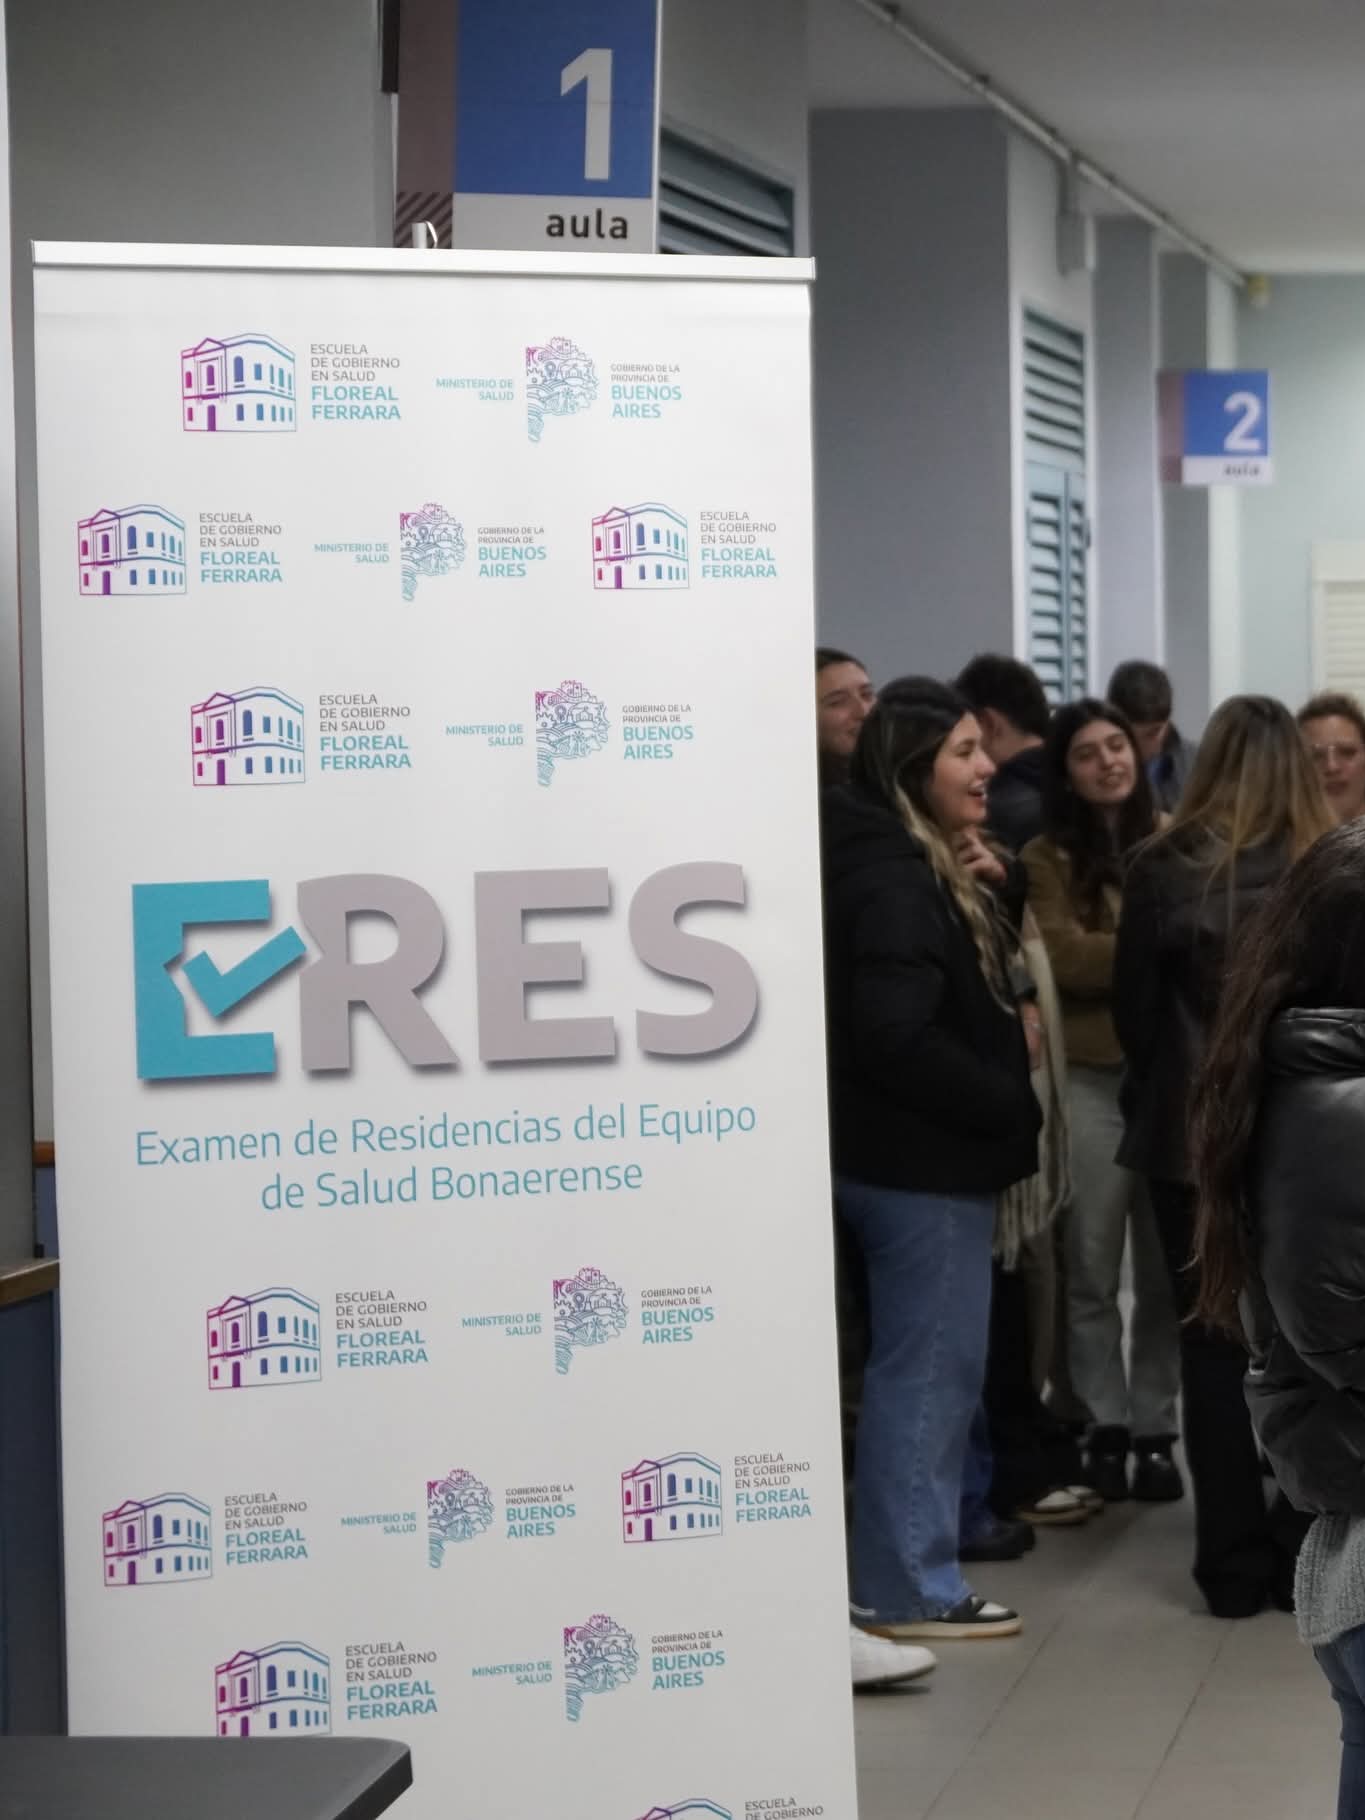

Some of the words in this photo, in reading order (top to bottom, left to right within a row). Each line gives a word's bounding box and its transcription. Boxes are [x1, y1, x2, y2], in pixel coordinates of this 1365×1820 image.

[560, 47, 614, 181] 1
[546, 209, 629, 240] aula
[310, 343, 369, 356] ESCUELA
[310, 356, 329, 369] DE
[331, 356, 401, 369] GOBIERNO
[610, 363, 655, 373] GOBIERNO
[655, 364, 668, 373] DE
[668, 364, 681, 374] LA
[311, 369, 329, 382] EN
[331, 369, 376, 382] SALUD
[435, 377, 497, 390] MINISTERIO
[496, 378, 514, 390] DE
[610, 373, 656, 384] PROVINCIA
[657, 374, 670, 384] DE
[311, 384, 399, 401] FLOREAL
[478, 390, 515, 401] SALUD
[611, 384, 683, 401] BUENOS
[311, 404, 402, 421] FERRARA
[611, 402, 662, 419] AIRES
[1224, 391, 1261, 450] 2
[199, 511, 253, 524] ESCUELA
[700, 511, 750, 521] ESCUELA
[199, 524, 217, 536] DE
[218, 524, 282, 536] GOBIERNO
[477, 527, 520, 535] GOBIERNO
[520, 526, 533, 536] DE
[533, 527, 545, 535] LA
[700, 522, 716, 533] DE
[717, 522, 777, 533] GOBIERNO
[199, 536, 217, 548] EN
[218, 536, 260, 548] SALUD
[313, 543, 373, 553] MINISTERIO
[374, 542, 389, 553] DE
[477, 535, 521, 545] PROVINCIA
[522, 535, 535, 545] DE
[700, 534, 717, 545] EN
[718, 534, 757, 545] SALUD
[199, 550, 281, 566] FLOREAL
[354, 552, 390, 565] SALUD
[478, 545, 547, 561] BUENOS
[700, 547, 776, 562] FLOREAL
[200, 567, 283, 584] FERRARA
[478, 562, 527, 578] AIRES
[701, 563, 778, 579] FERRARA
[319, 693, 378, 706] ESCUELA
[319, 707, 337, 720] DE
[340, 706, 411, 719] GOBIERNO
[622, 704, 667, 714] GOBIERNO
[667, 704, 679, 713] DE
[680, 703, 692, 713] LA
[319, 721, 339, 733] EN
[341, 719, 386, 732] SALUD
[622, 714, 668, 724] PROVINCIA
[669, 714, 681, 723] DE
[445, 723, 509, 736] MINISTERIO
[507, 723, 524, 735] DE
[622, 724, 694, 742] BUENOS
[319, 735, 409, 752] FLOREAL
[487, 735, 524, 748] SALUD
[623, 743, 674, 761] AIRES
[320, 753, 412, 771] FERRARA
[131, 861, 760, 1079] ERES
[135, 1130, 281, 1167] Examen
[293, 1118, 338, 1157] de
[351, 1109, 562, 1153] Residencias
[573, 1103, 625, 1141] del
[639, 1100, 756, 1145] Equipo
[261, 1172, 305, 1211] de
[315, 1165, 417, 1208] Salud
[431, 1163, 643, 1201] Bonaerense
[335, 1289, 396, 1304] ESCUELA
[640, 1287, 686, 1299] GOBIERNO
[687, 1286, 700, 1296] DE
[700, 1285, 713, 1295] LA
[335, 1304, 354, 1317] DE
[357, 1300, 428, 1316] GOBIERNO
[641, 1297, 688, 1309] PROVINCIA
[689, 1296, 702, 1305] DE
[335, 1318, 355, 1331] EN
[357, 1315, 403, 1329] SALUD
[461, 1313, 524, 1329] MINISTERIO
[525, 1312, 542, 1324] DE
[641, 1306, 715, 1327] BUENOS
[505, 1324, 542, 1337] SALUD
[642, 1325, 694, 1345] AIRES
[336, 1329, 426, 1350] FLOREAL
[336, 1347, 429, 1369] FERRARA
[734, 1452, 784, 1467] ESCUELA
[734, 1466, 750, 1478] DE
[752, 1461, 811, 1476] GOBIERNO
[734, 1478, 751, 1490] EN
[752, 1474, 791, 1488] SALUD
[505, 1485, 549, 1497] GOBIERNO
[549, 1484, 562, 1493] DE
[562, 1484, 575, 1493] LA
[735, 1487, 810, 1506] FLOREAL
[224, 1491, 278, 1507] ESCUELA
[505, 1494, 550, 1506] PROVINCIA
[551, 1494, 563, 1503] DE
[224, 1507, 241, 1519] DE
[243, 1501, 308, 1517] GOBIERNO
[505, 1503, 577, 1523] BUENOS
[735, 1503, 812, 1524] FERRARA
[224, 1519, 242, 1531] EN
[243, 1514, 285, 1529] SALUD
[340, 1513, 401, 1527] MINISTERIO
[402, 1511, 417, 1523] DE
[383, 1522, 417, 1535] SALUD
[506, 1520, 556, 1539] AIRES
[225, 1527, 306, 1549] FLOREAL
[225, 1544, 309, 1566] FERRARA
[651, 1631, 697, 1645] GOBIERNO
[697, 1630, 711, 1640] DE
[711, 1629, 724, 1639] LA
[345, 1640, 406, 1657] ESCUELA
[651, 1642, 699, 1655] PROVINCIA
[699, 1640, 712, 1650] DE
[345, 1657, 364, 1670] DE
[367, 1651, 438, 1668] GOBIERNO
[471, 1662, 536, 1677] MINISTERIO
[536, 1660, 553, 1672] DE
[651, 1650, 726, 1673] BUENOS
[345, 1670, 365, 1684] EN
[367, 1666, 413, 1681] SALUD
[515, 1672, 553, 1686] SALUD
[651, 1670, 705, 1691] AIRES
[346, 1679, 436, 1703] FLOREAL
[346, 1697, 438, 1721] FERRARA
[744, 1796, 797, 1812] ESCUELA
